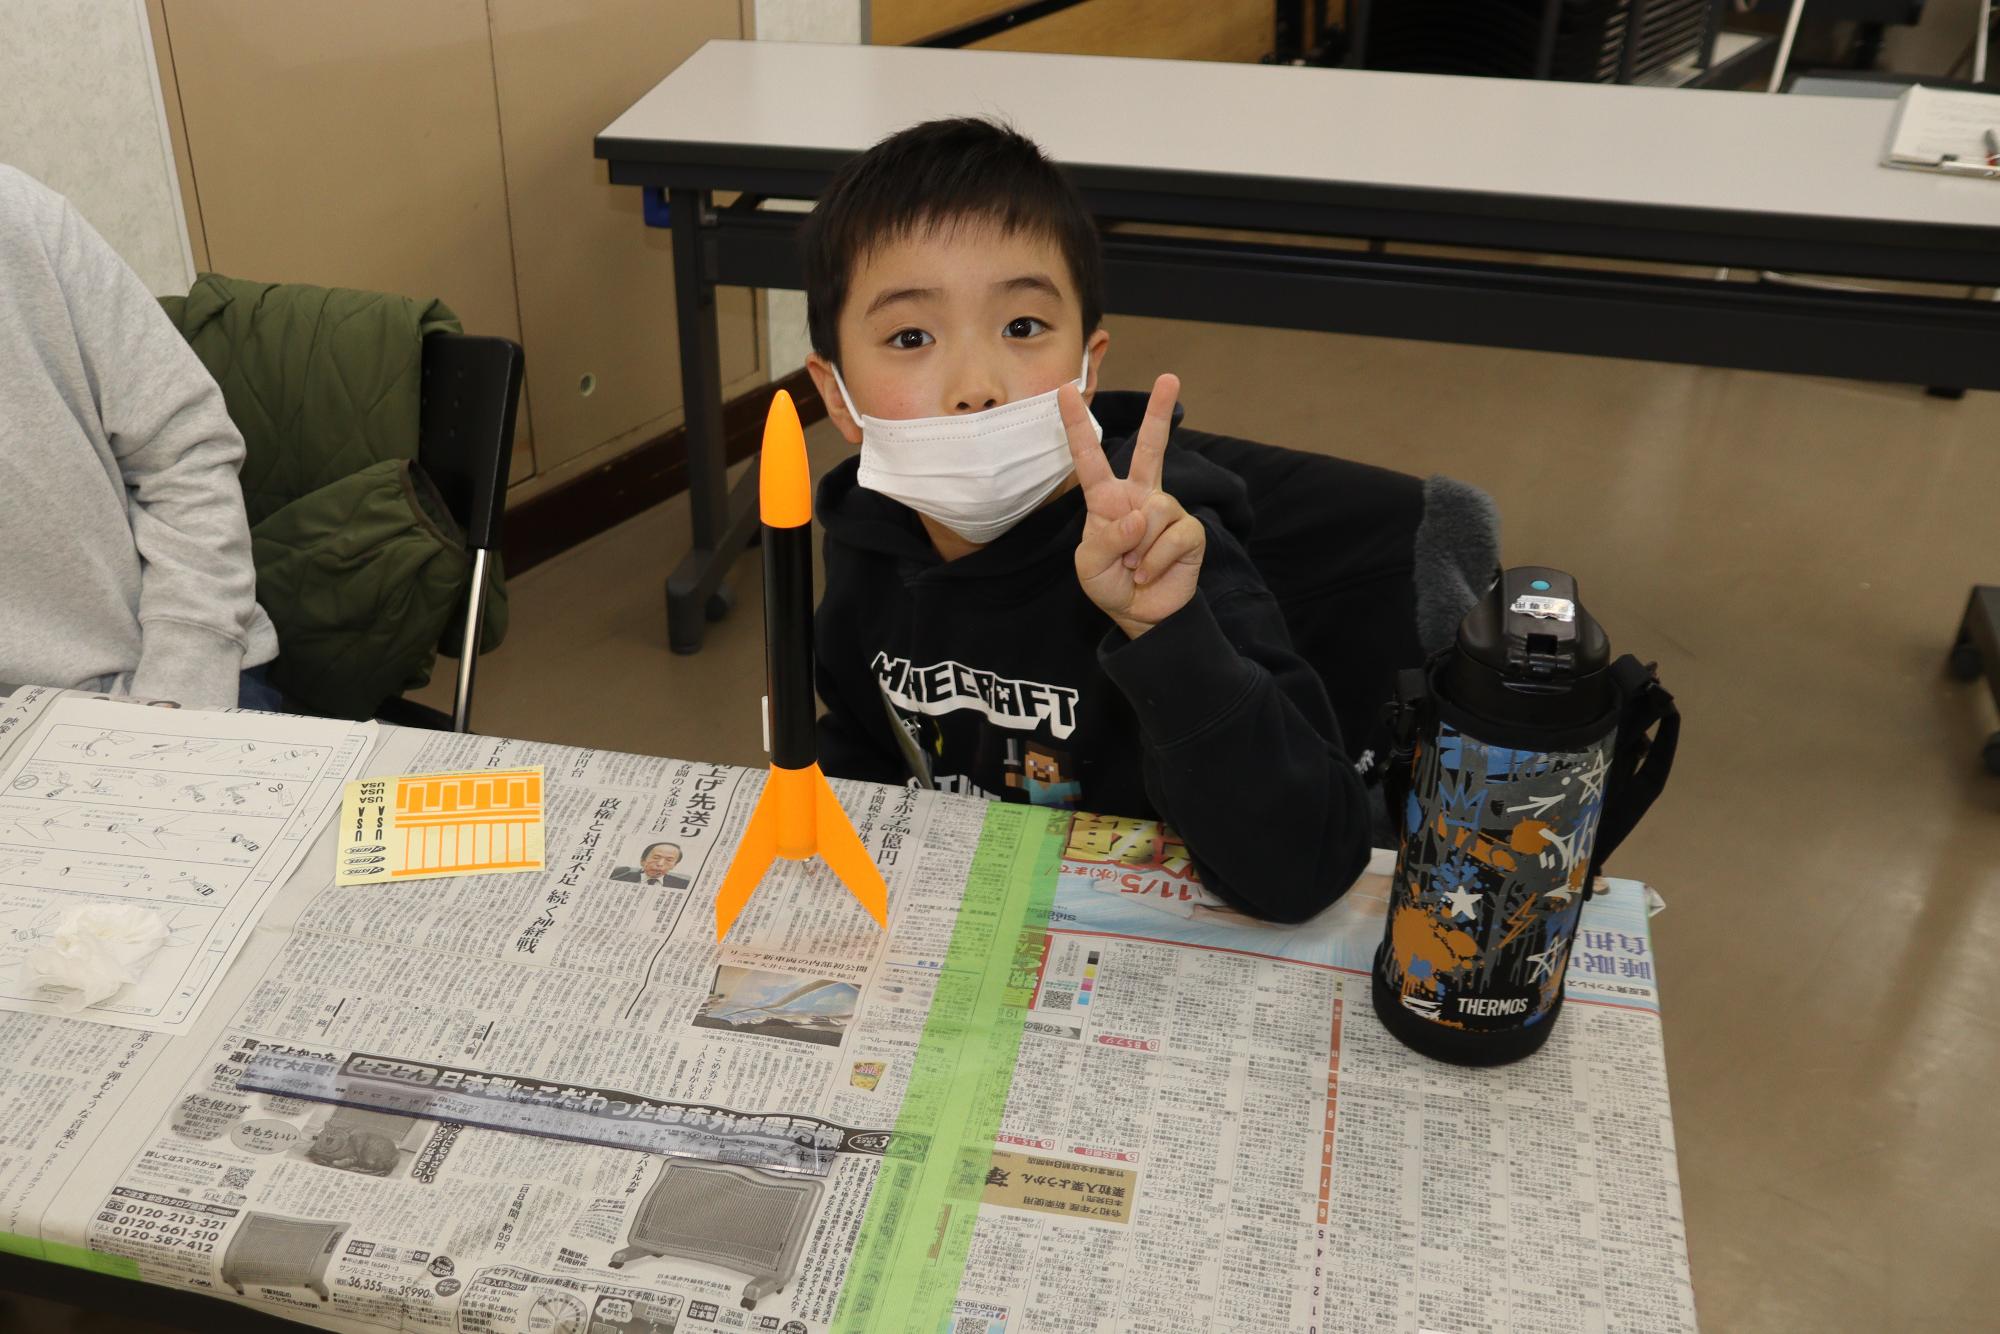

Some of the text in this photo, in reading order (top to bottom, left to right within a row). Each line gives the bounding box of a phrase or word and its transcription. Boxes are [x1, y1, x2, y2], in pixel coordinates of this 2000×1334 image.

[359, 796, 383, 804] USA
[360, 788, 384, 796] USA
[680, 763, 735, 838] 上げ先送り
[515, 797, 622, 954] 政権と対話不足 続く神経戦
[1571, 929, 1649, 956] 負担
[1458, 998, 1528, 1016] THERMOS
[352, 1059, 431, 1084] とことん
[241, 1125, 298, 1142] きもちいい
[1021, 1173, 1126, 1198] 栗粒入栗ようかん
[1321, 1177, 1329, 1187] 7
[1023, 1195, 1122, 1218] 新栗使用 令和7年産
[1081, 1194, 1123, 1207] 本日発売!
[126, 1204, 227, 1230] 0120-213-321
[118, 1216, 220, 1242] 0120-661-510
[1317, 1229, 1324, 1239] 5
[112, 1226, 214, 1253] 0120-587-412
[1316, 1248, 1323, 1257] 4
[1314, 1267, 1321, 1277] 3
[1313, 1286, 1319, 1296] 2
[1311, 1306, 1317, 1316] 1
